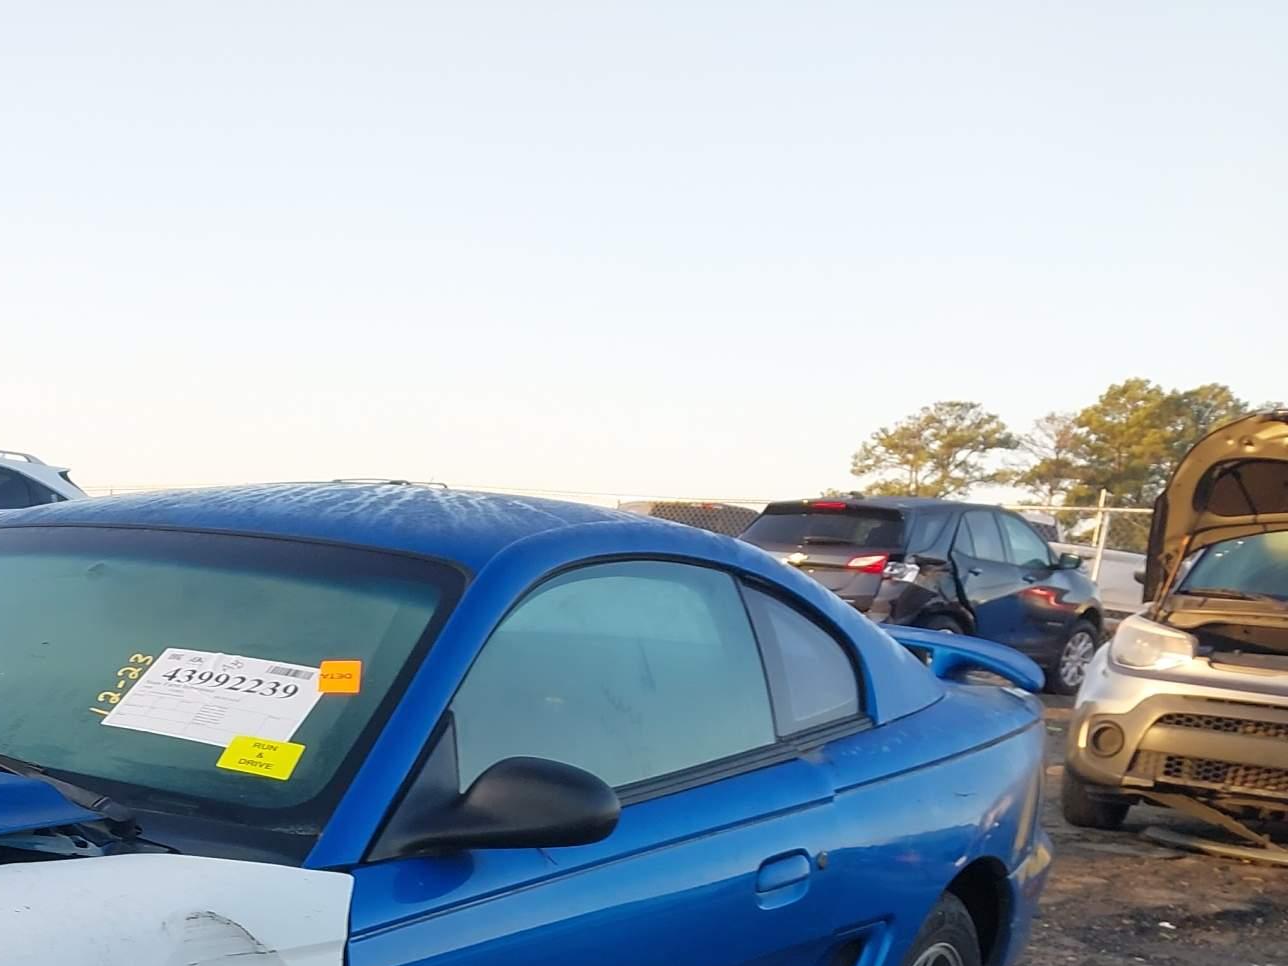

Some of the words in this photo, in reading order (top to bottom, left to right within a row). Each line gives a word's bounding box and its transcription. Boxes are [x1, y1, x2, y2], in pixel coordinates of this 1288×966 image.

[88, 652, 154, 716] 12-23
[161, 667, 300, 699] 43992239
[253, 741, 279, 752] RUN
[237, 758, 275, 771] DRIVE
